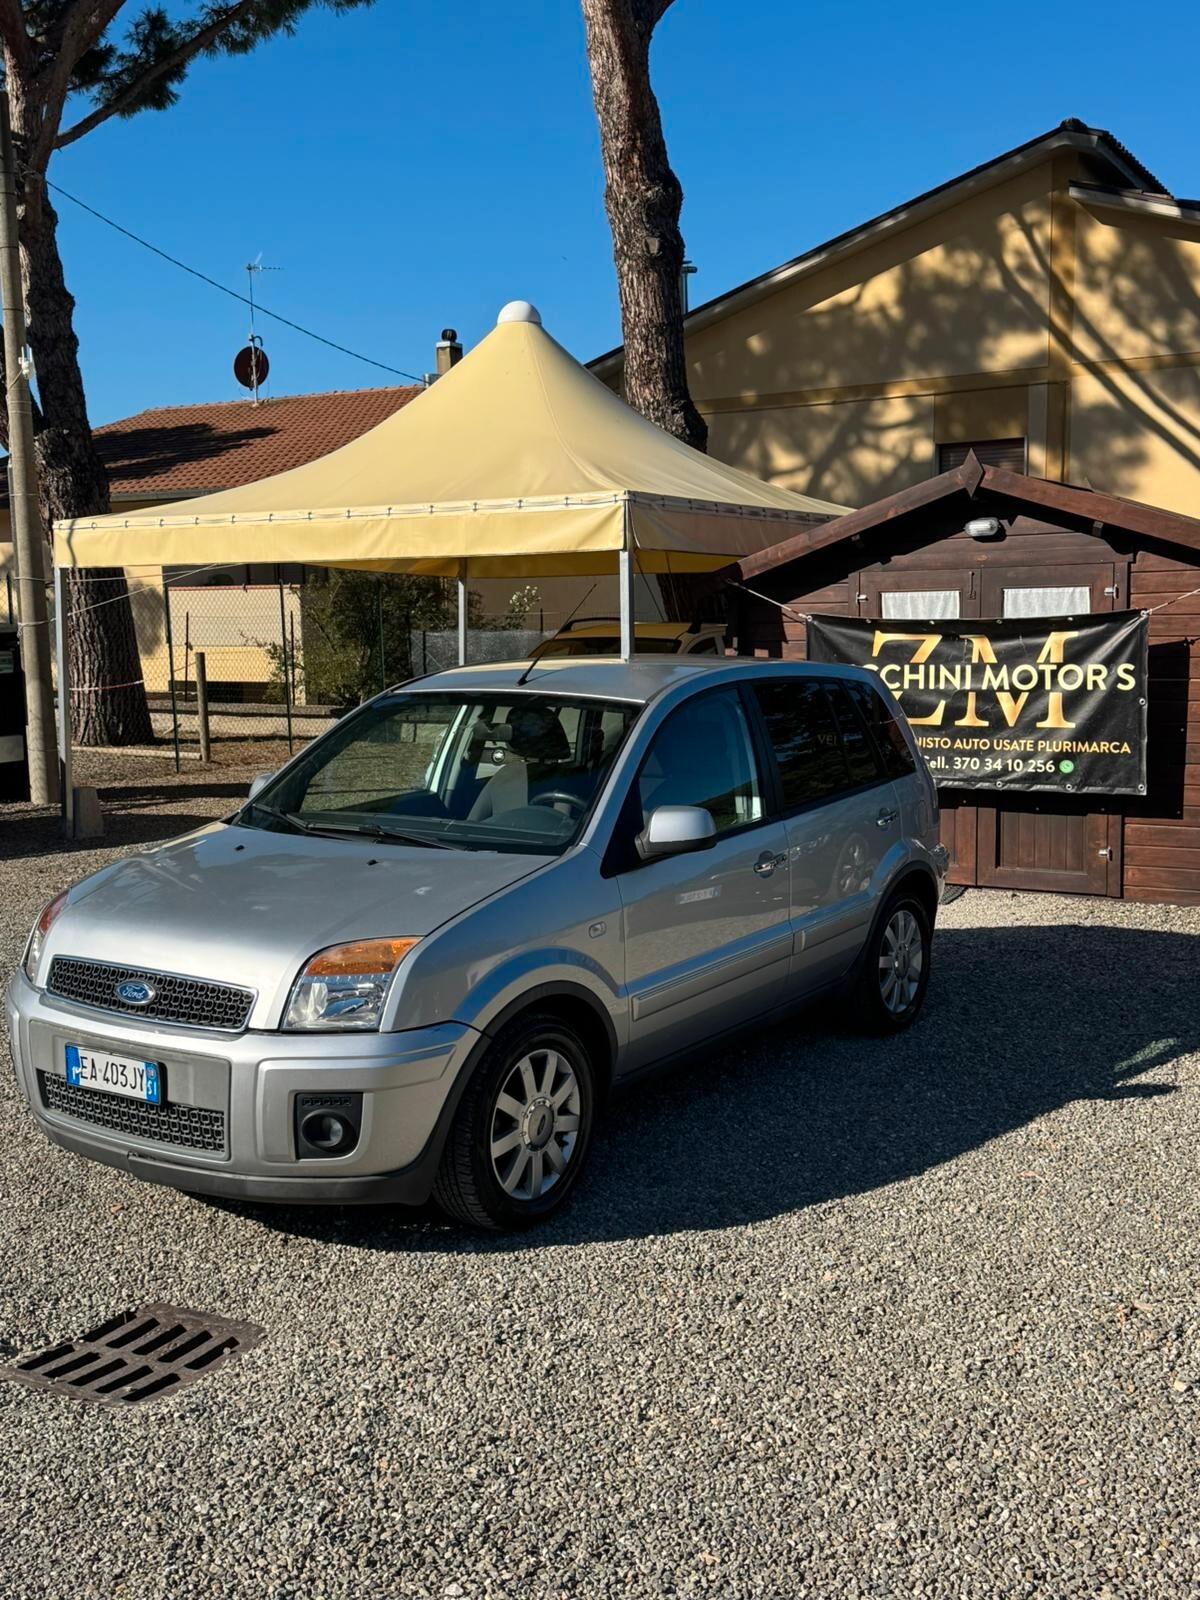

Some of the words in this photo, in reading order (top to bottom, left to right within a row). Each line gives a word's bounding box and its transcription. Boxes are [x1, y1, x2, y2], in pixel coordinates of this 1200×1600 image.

[863, 663, 972, 690] CHINI
[953, 738, 990, 750] AUTO
[993, 739, 1034, 752] USATE
[1037, 740, 1131, 754] PLURIMARCA
[953, 757, 980, 770] 370
[984, 758, 1002, 771] 34
[1006, 759, 1023, 772] 10
[1027, 760, 1055, 773] 256
[80, 1056, 97, 1081] EA
